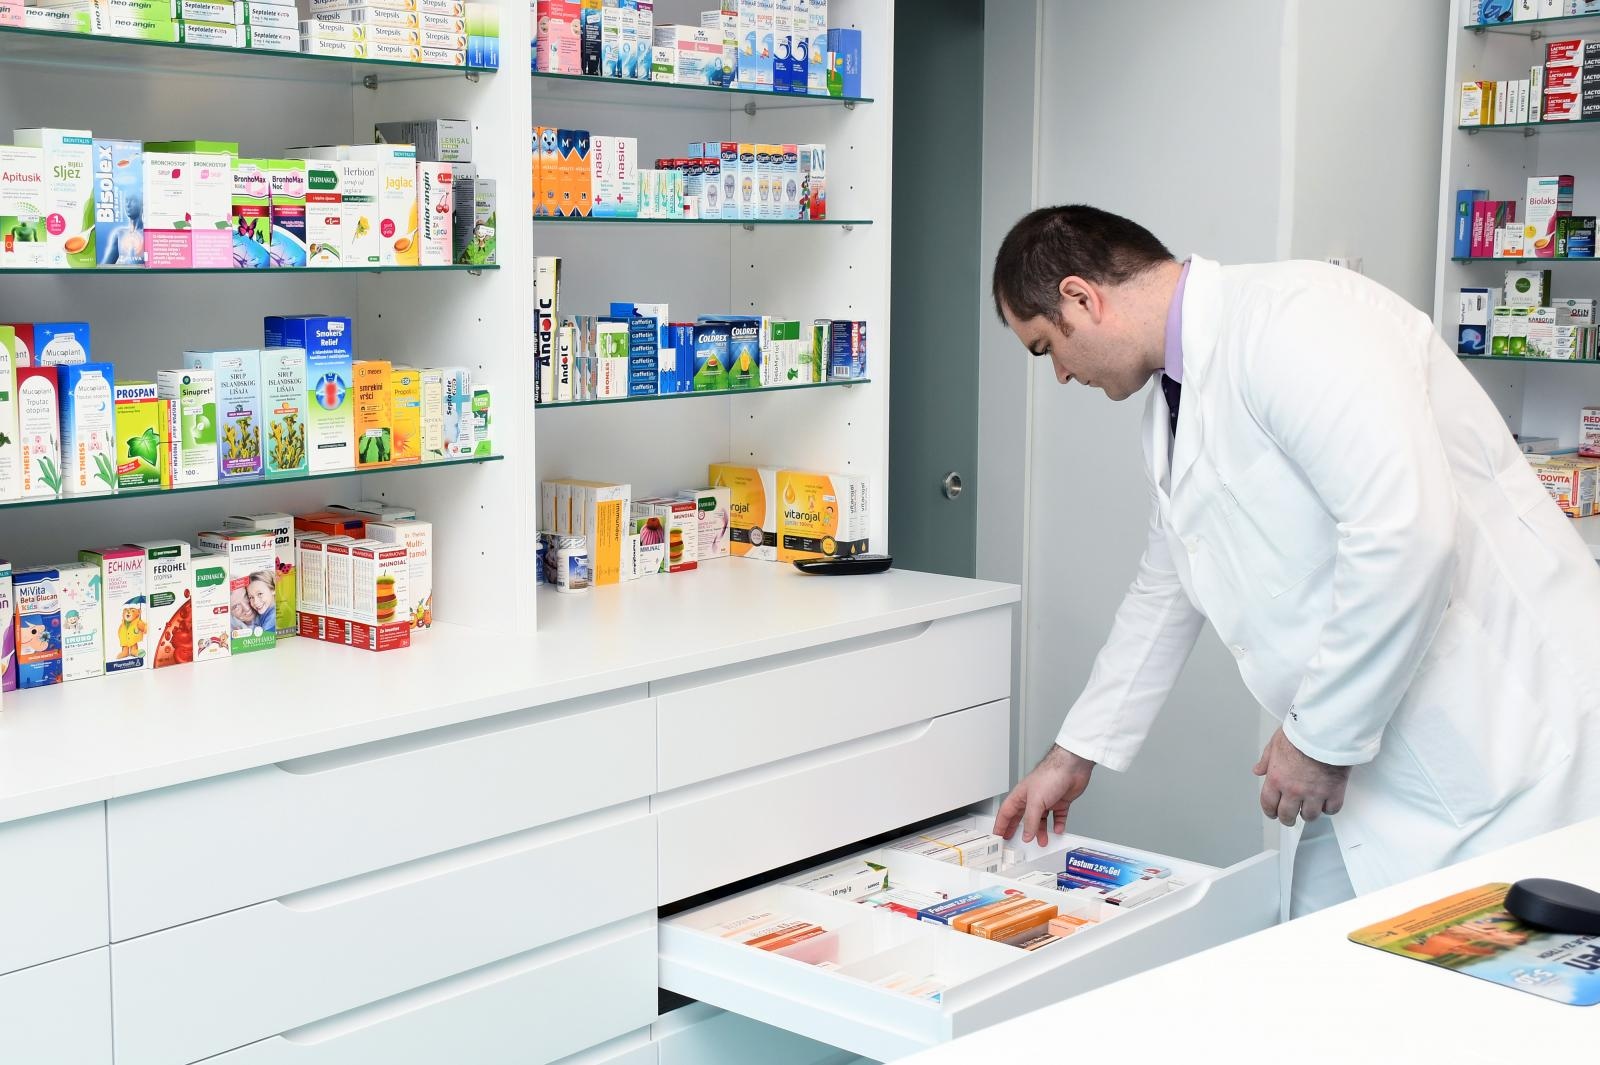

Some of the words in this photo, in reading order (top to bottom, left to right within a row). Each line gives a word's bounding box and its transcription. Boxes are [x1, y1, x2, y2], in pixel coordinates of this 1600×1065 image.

[129, 1, 153, 11] angin
[184, 1, 209, 11] Septolete
[25, 8, 42, 17] neo
[44, 10, 71, 20] angin
[252, 8, 278, 18] Septolete
[316, 12, 341, 22] Strepsils
[374, 9, 400, 19] Strepsils
[114, 19, 131, 27] neo
[133, 20, 156, 30] angin
[424, 15, 449, 25] Strepsils
[188, 25, 213, 35] Septolete
[319, 23, 345, 33] Strepsils
[375, 27, 401, 37] Strepsils
[254, 31, 280, 41] Septolete
[425, 32, 450, 41] Strepsils
[319, 40, 346, 51] Strepsils
[377, 44, 403, 53] Strepsils
[423, 48, 448, 58] Strepsils
[562, 139, 569, 148] M
[594, 140, 603, 179] nasic
[617, 142, 625, 180] nasic
[721, 151, 738, 161] Olynth
[812, 148, 825, 172] N
[53, 165, 81, 181] Sljez
[343, 165, 374, 177] Herbion
[704, 164, 720, 174] Olynth
[2, 171, 42, 183] Apitusik
[233, 174, 266, 184] BronhoMax
[272, 174, 304, 184] BronhoMax
[385, 175, 413, 190] Jaglac
[1529, 197, 1556, 206] Biolaks
[631, 318, 653, 327] caffetin
[631, 331, 653, 340] caffetin
[732, 325, 758, 336] COLDREX
[320, 338, 339, 347] Relief
[698, 332, 728, 344] COLDREX
[46, 349, 81, 357] Mucoplant
[631, 345, 654, 353] caffetin
[632, 357, 654, 365] caffetin
[632, 370, 654, 378] caffetin
[220, 379, 256, 388] ISLANDSKOG
[268, 377, 302, 387] ISLANDSKOG
[360, 382, 383, 392] smrekini
[22, 388, 52, 396] Mucoplant
[77, 385, 108, 393] Mucoplant
[182, 388, 211, 397] Sinupret
[229, 387, 249, 396] LIŠAJA
[276, 384, 295, 394] LIŠAJA
[632, 383, 655, 392] caffetin
[116, 387, 155, 399] PROSPAN
[730, 502, 750, 514] rojal
[784, 507, 821, 523] vitarojal
[200, 539, 228, 550] Immun44
[230, 540, 273, 552] Immun44
[108, 559, 143, 574] ECHINAX
[153, 562, 187, 574] FEROHEL
[378, 559, 408, 569] IMUNDIAL
[19, 586, 46, 597] MiVita
[20, 595, 35, 604] Beta
[36, 593, 58, 602] Glucan
[1068, 857, 1094, 871] Fastum
[1094, 864, 1109, 876] 2,5%
[1108, 866, 1122, 877] Gel
